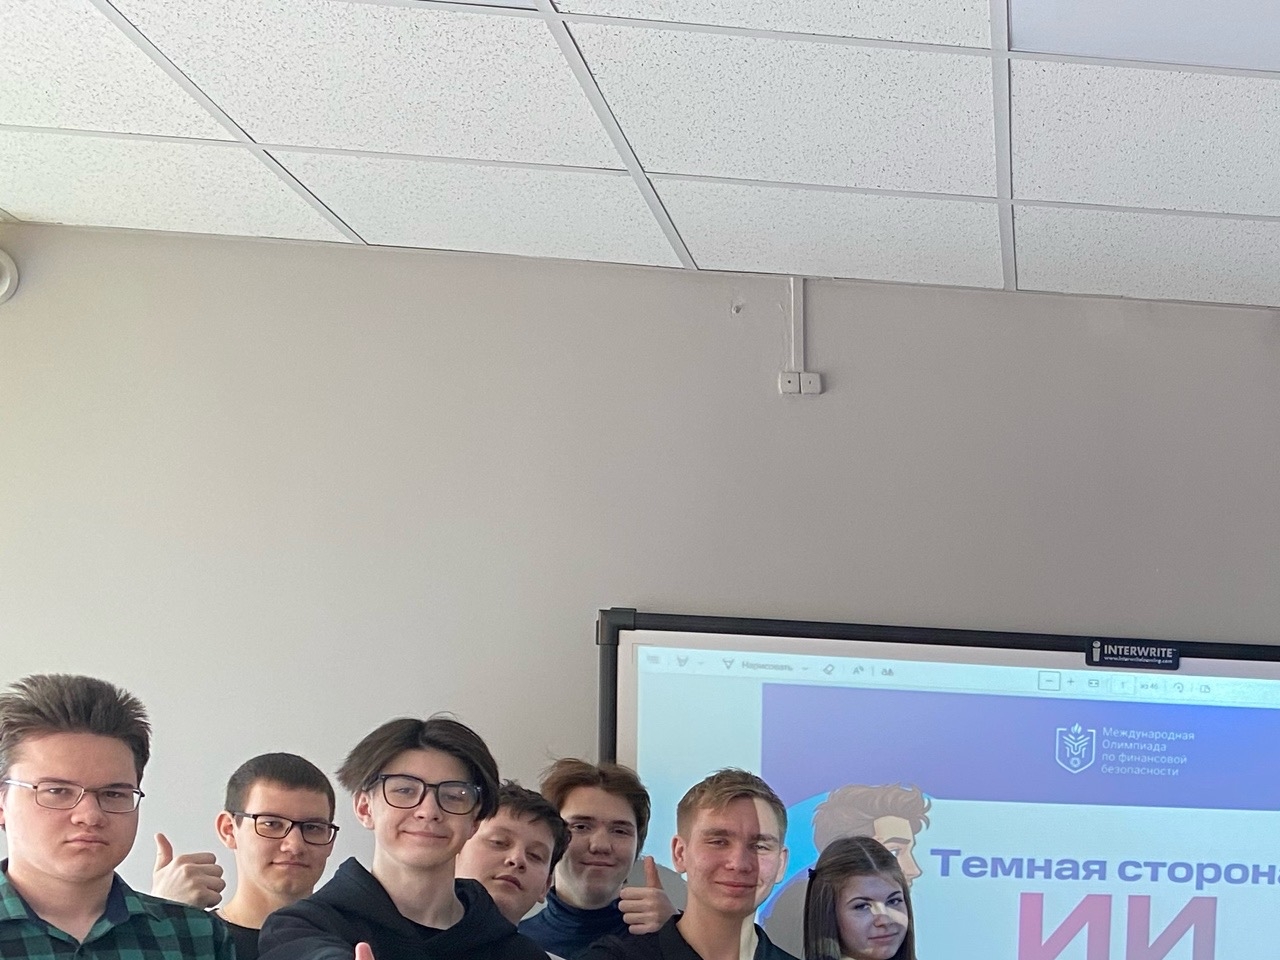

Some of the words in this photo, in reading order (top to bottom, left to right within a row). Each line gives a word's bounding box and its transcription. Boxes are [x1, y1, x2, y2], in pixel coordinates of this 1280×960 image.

[1104, 644, 1173, 658] INTERWRITE
[1102, 726, 1195, 741] Международная
[1102, 738, 1167, 752] Олимпиада
[1101, 753, 1116, 762] по
[1118, 752, 1188, 765] финансовой
[1101, 764, 1180, 776] безопасности
[930, 848, 1108, 881] Темная
